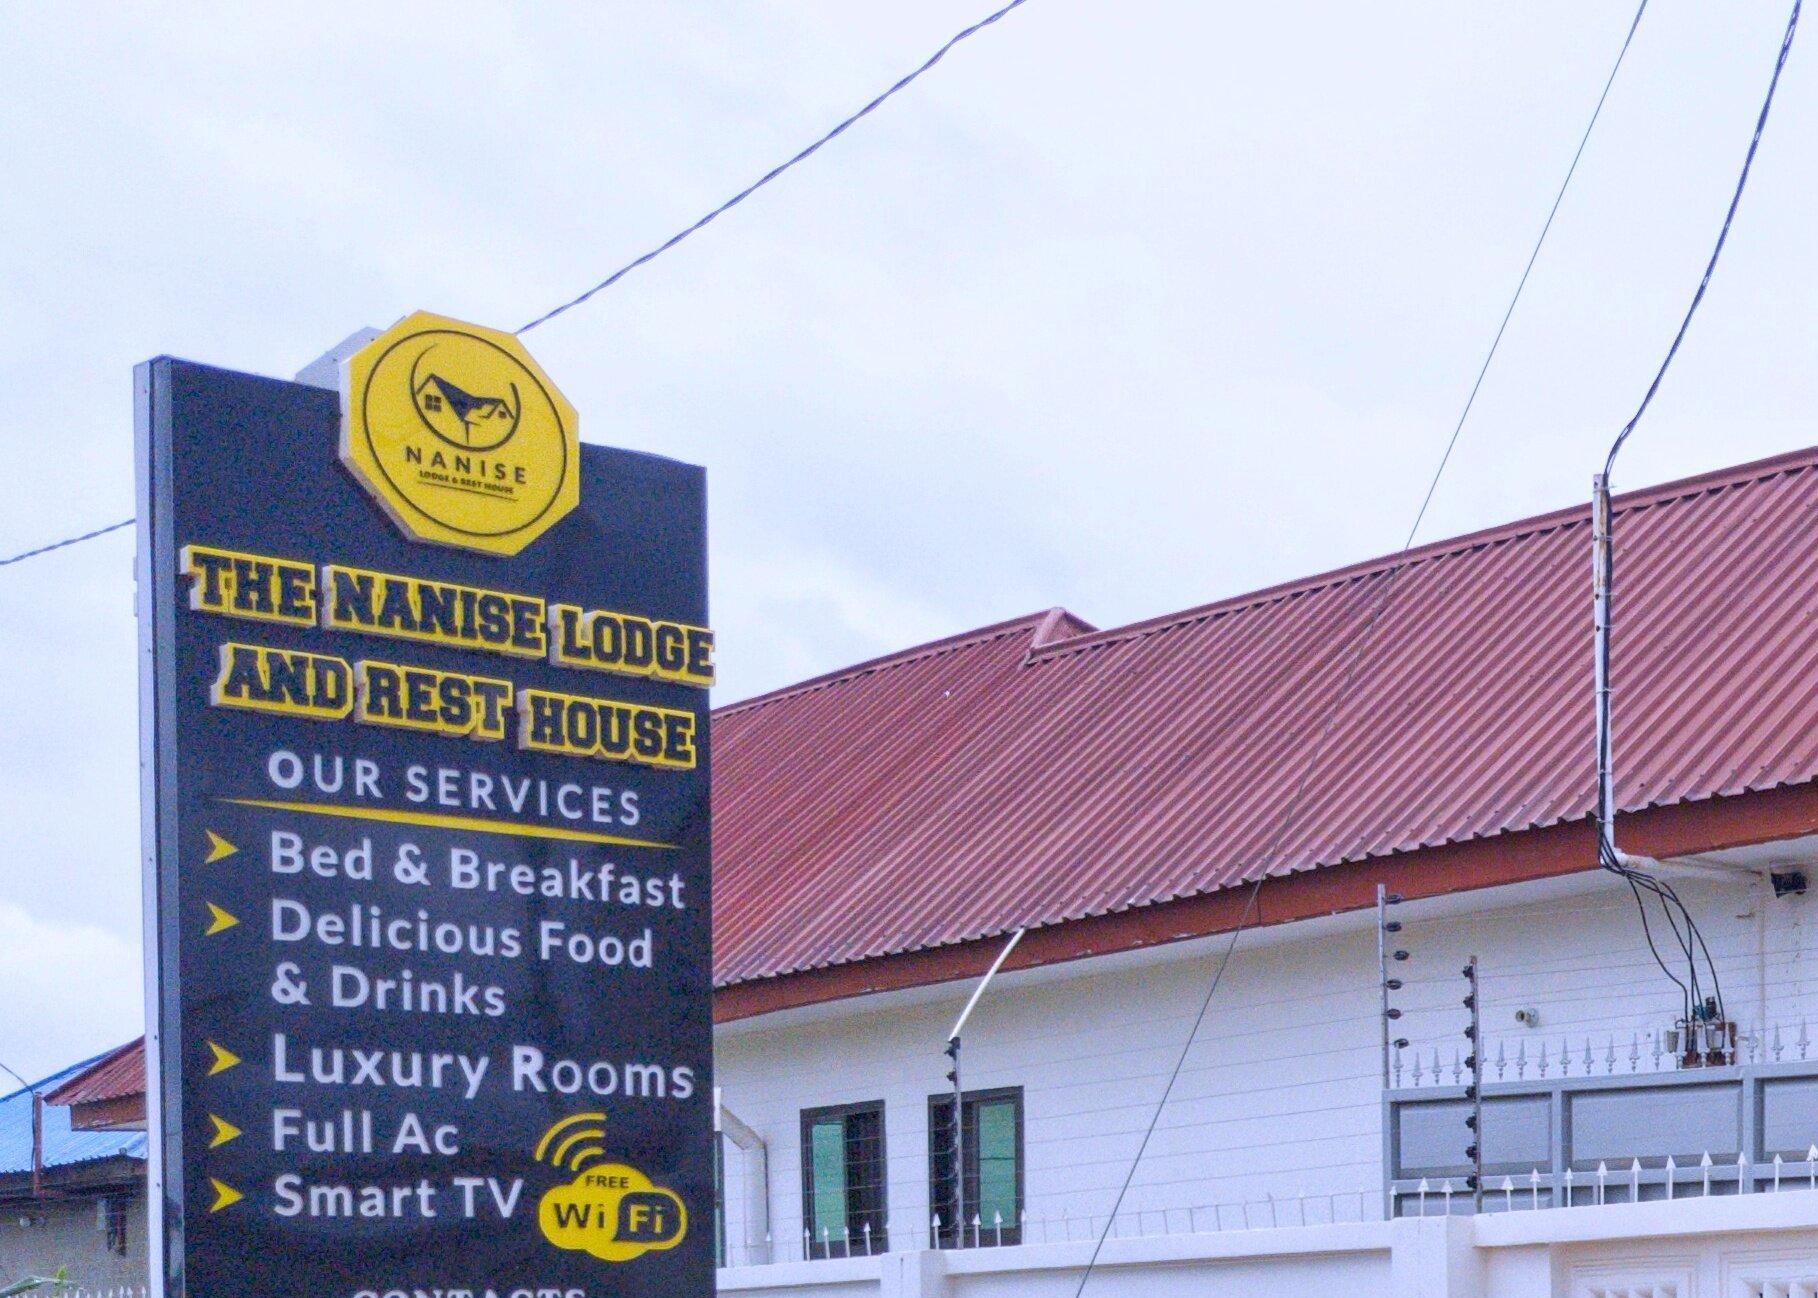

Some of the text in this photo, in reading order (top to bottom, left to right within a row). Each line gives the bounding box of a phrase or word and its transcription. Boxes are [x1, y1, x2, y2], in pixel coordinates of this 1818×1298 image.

[405, 446, 527, 485] NANISE
[188, 548, 716, 686] THE NANISE LODGE
[219, 644, 696, 769] AND REST HOUSE
[268, 750, 641, 826] OUR SERVICES
[270, 831, 686, 910] Bed & Breakfast
[271, 898, 653, 969] Delicious Food
[271, 962, 506, 1018] & Drinks
[274, 1033, 695, 1100] Luxury Rooms
[273, 1109, 460, 1155] Full Ac
[273, 1174, 524, 1219] Smart TV
[585, 1175, 629, 1190] FREE
